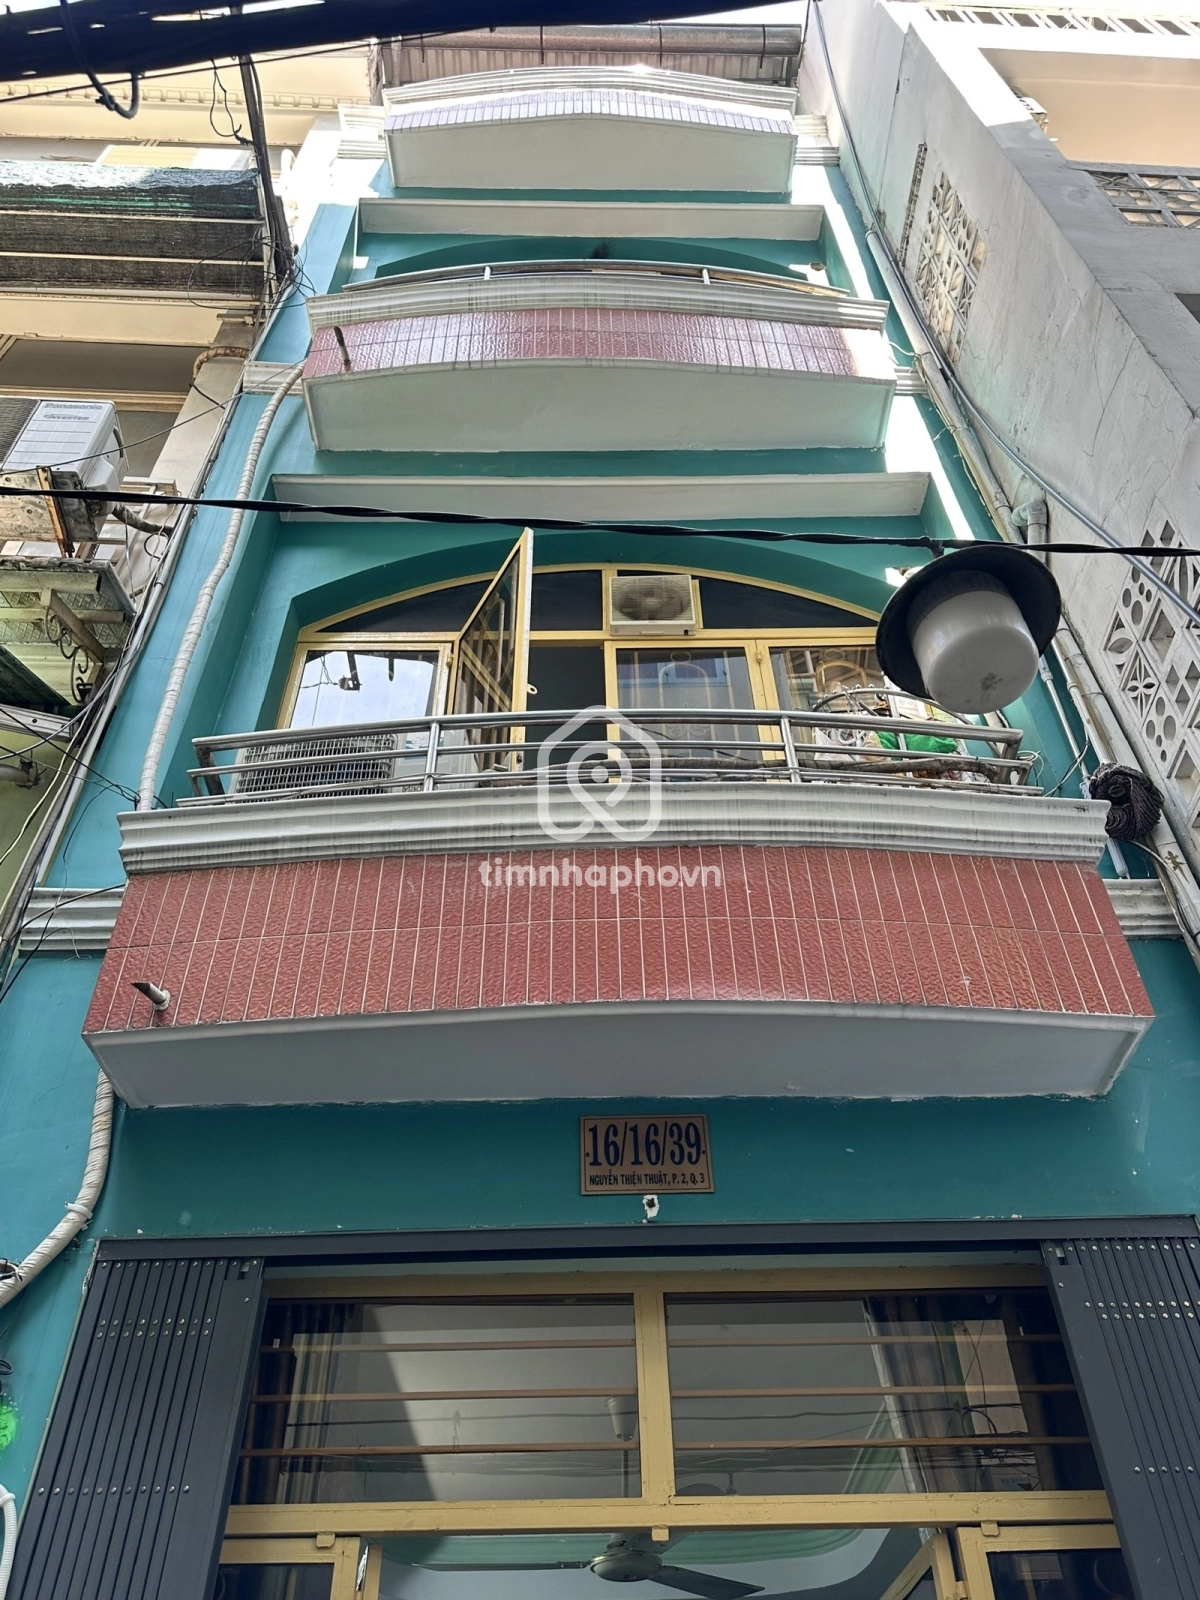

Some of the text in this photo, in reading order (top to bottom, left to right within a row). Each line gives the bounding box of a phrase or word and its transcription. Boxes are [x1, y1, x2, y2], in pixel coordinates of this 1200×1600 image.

[588, 1121, 701, 1167] 16/16/39
[589, 1169, 705, 1187] NGUYỄN THIỆN THUẬT, P. 2, Q. 3
